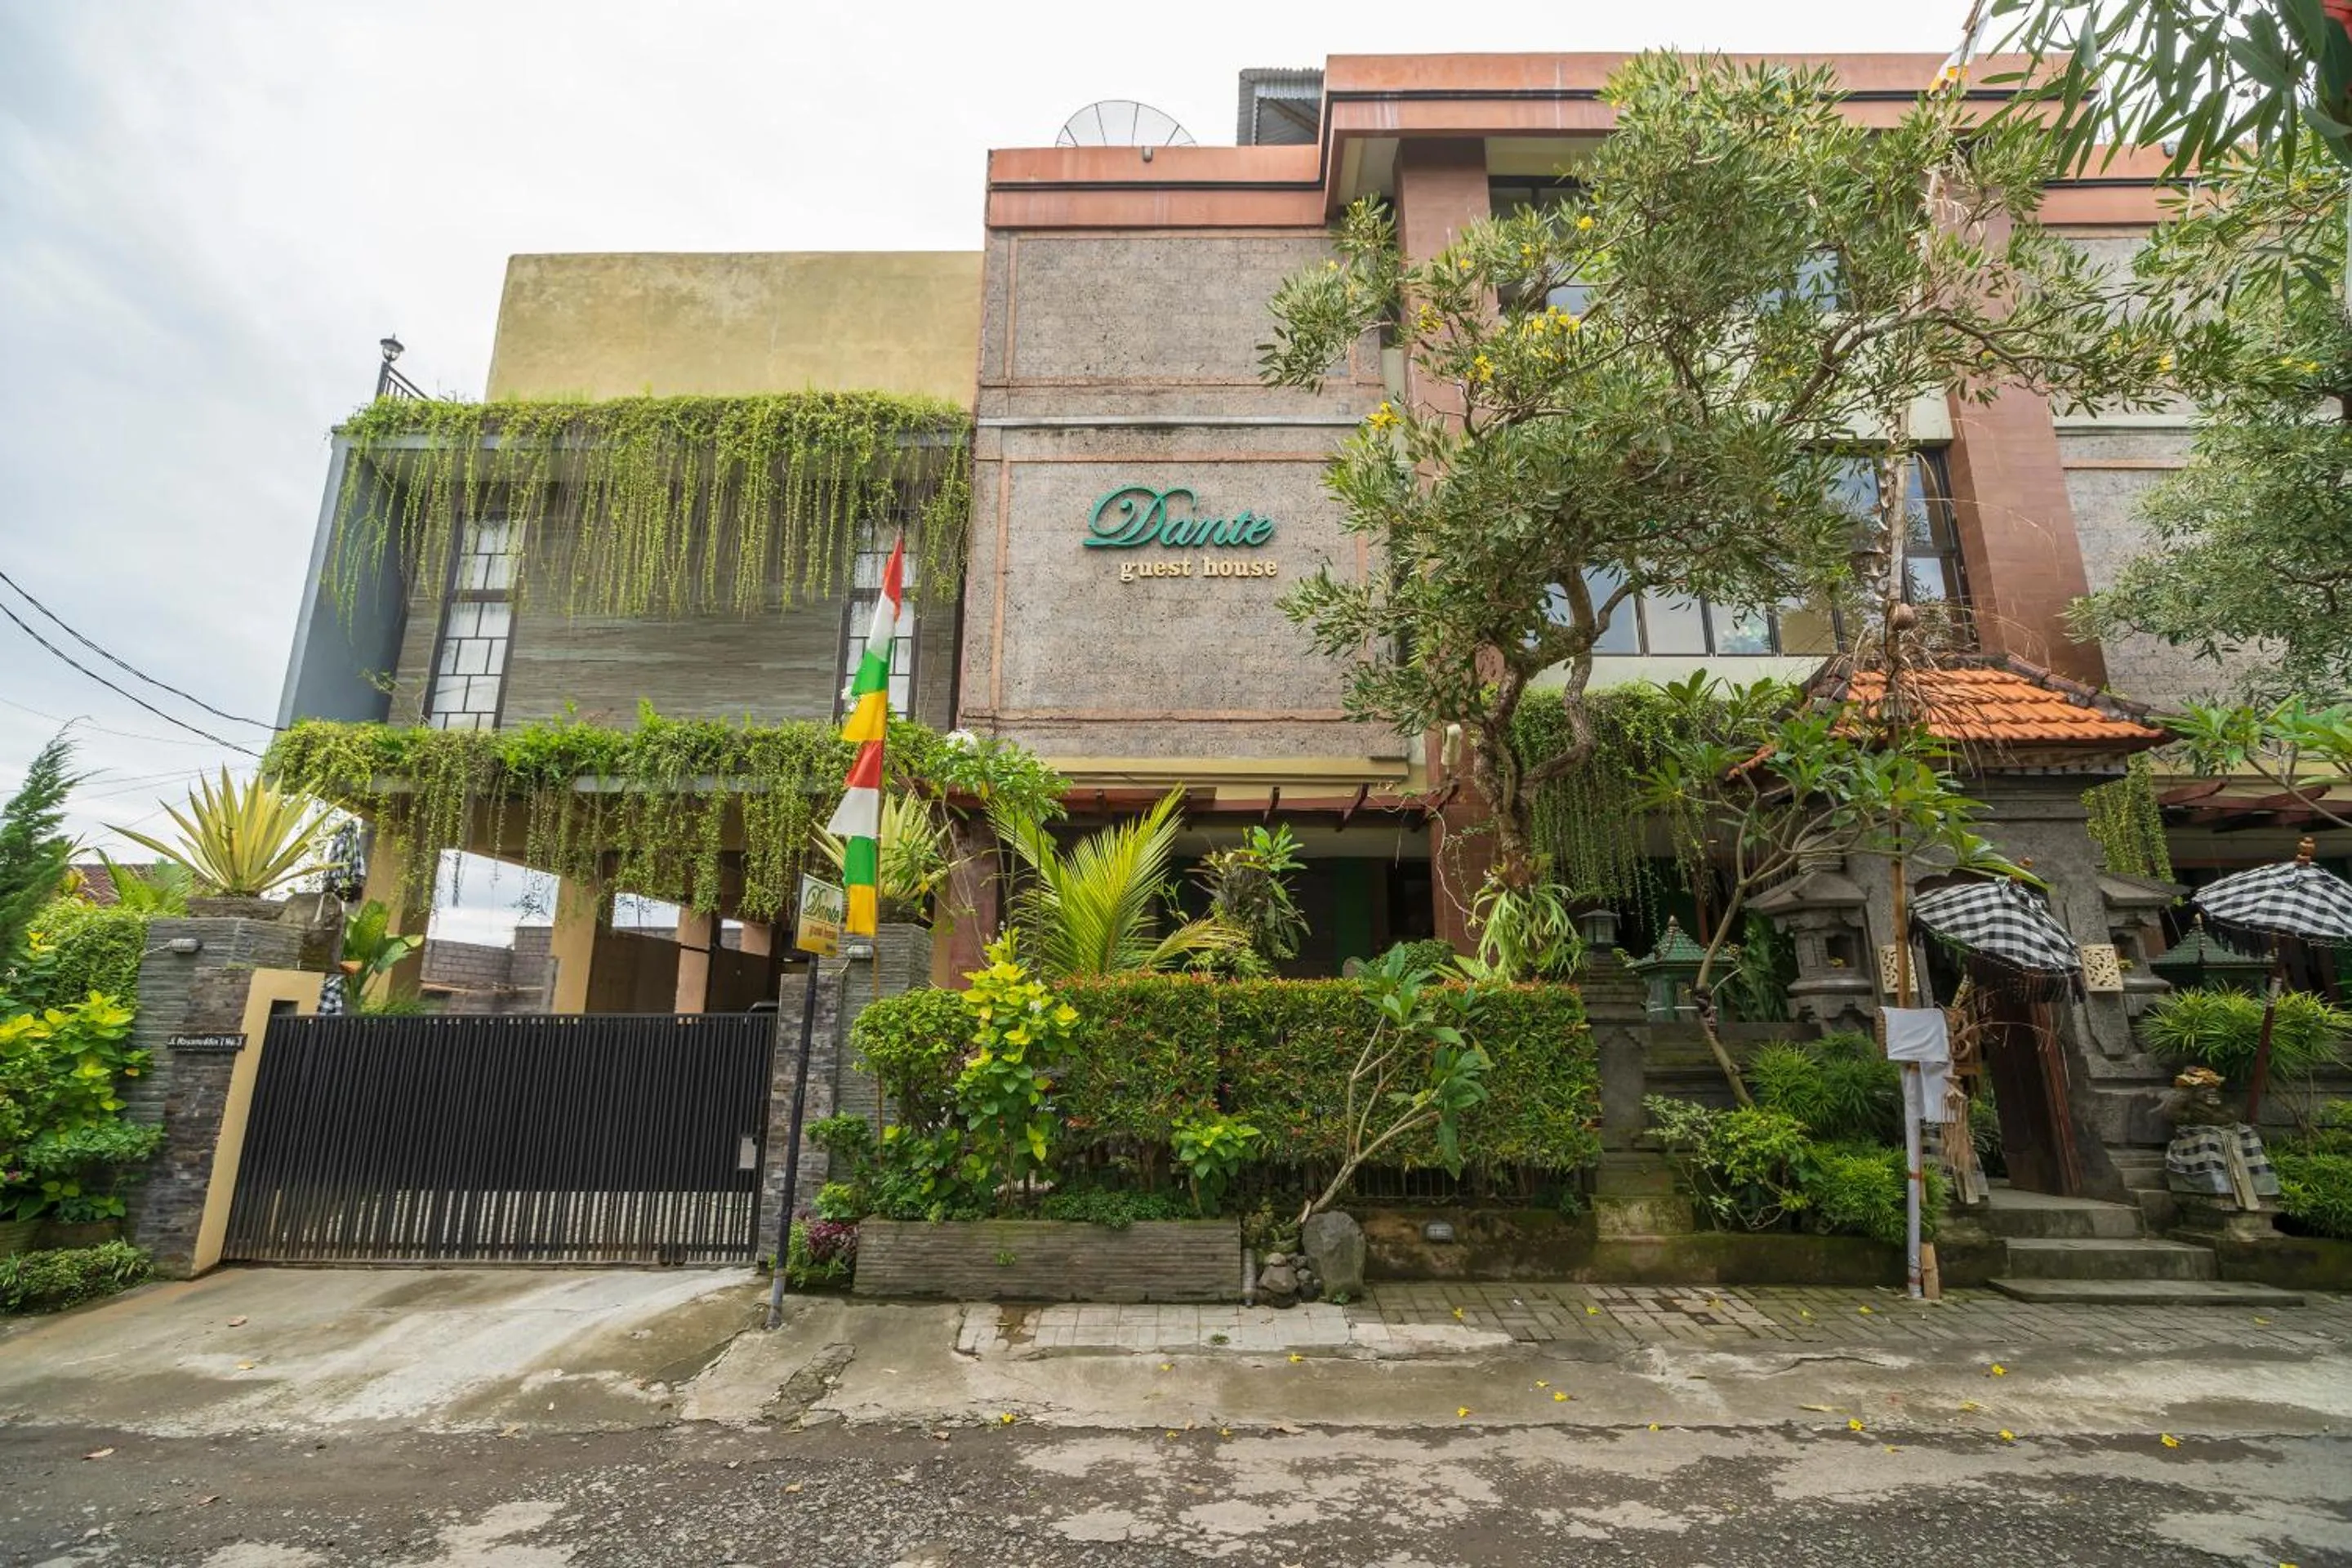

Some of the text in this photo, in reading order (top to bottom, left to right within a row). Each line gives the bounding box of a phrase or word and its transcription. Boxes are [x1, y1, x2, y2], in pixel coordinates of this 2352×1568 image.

[1082, 485, 1276, 549] Dante
[1120, 557, 1278, 582] guest house
